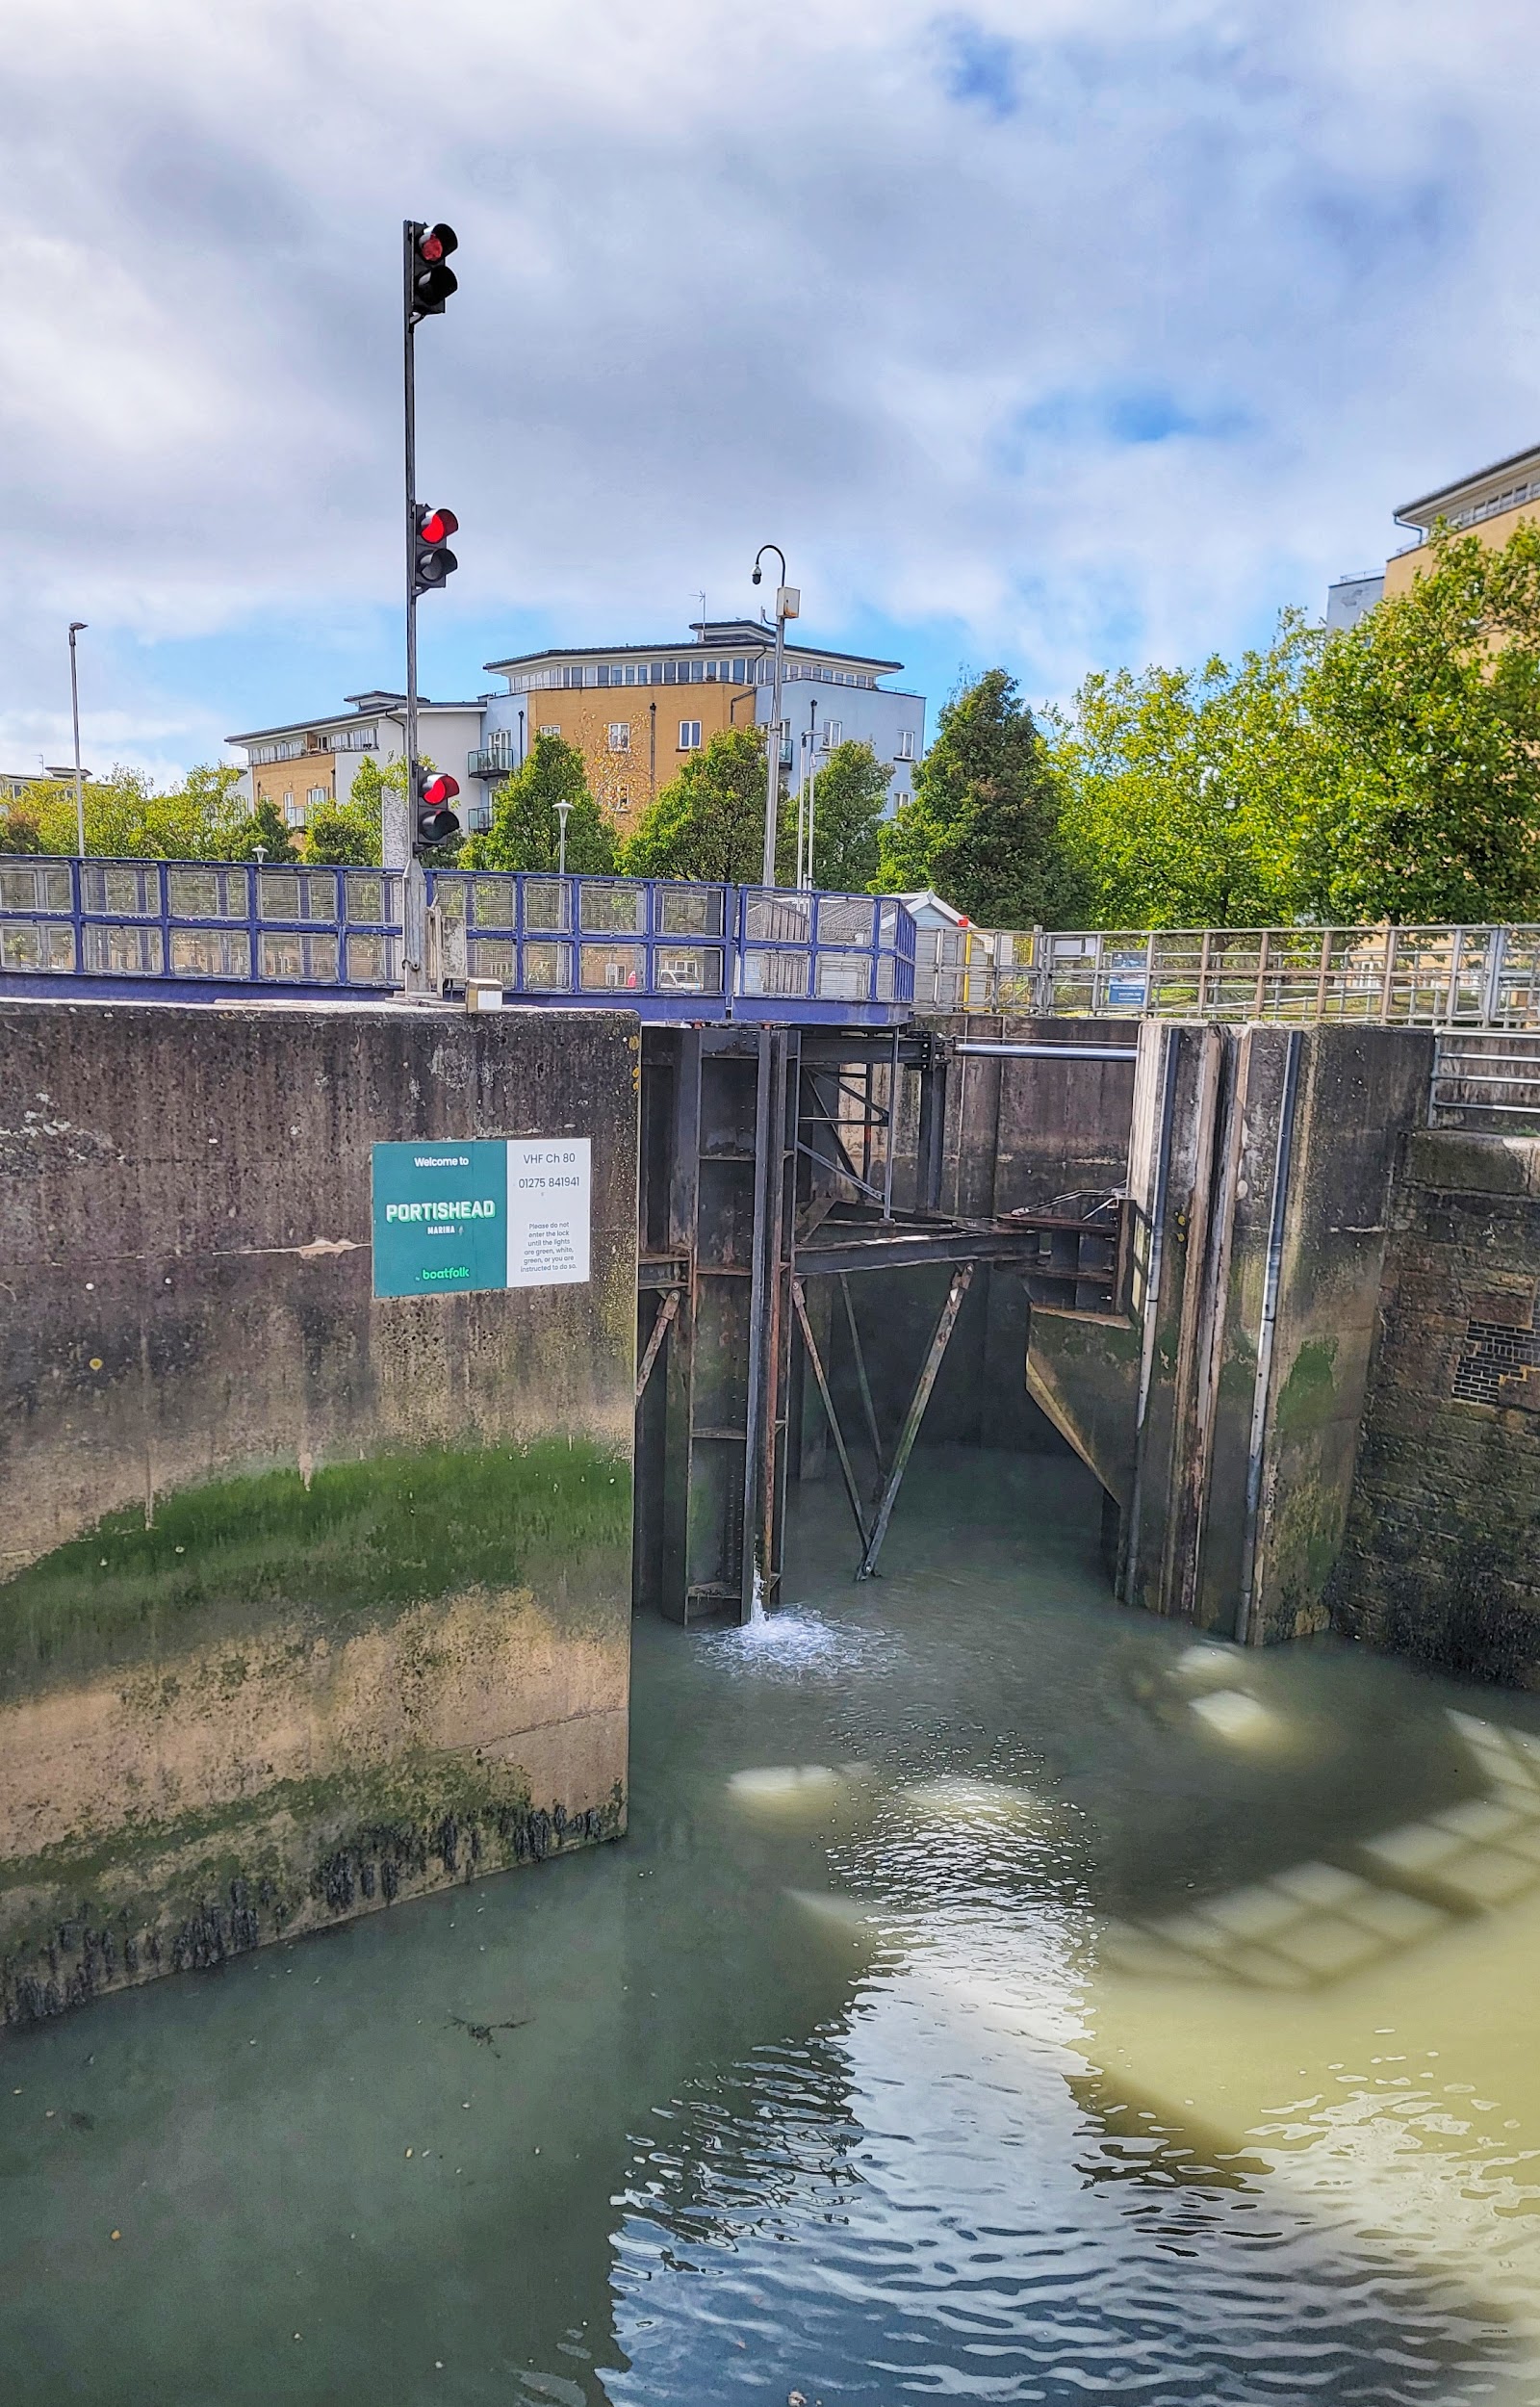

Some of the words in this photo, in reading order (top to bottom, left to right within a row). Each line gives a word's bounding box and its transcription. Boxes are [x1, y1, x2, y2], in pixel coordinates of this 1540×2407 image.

[414, 1156, 458, 1167] Welcome
[459, 1156, 470, 1166] to
[523, 1153, 544, 1164] VHF
[546, 1152, 560, 1163] Ch
[563, 1152, 576, 1163] 80
[518, 1178, 546, 1188] 01275
[548, 1177, 579, 1188] 841941
[386, 1200, 496, 1223] PORTISHEAD
[427, 1225, 455, 1235] MARINA
[553, 1238, 570, 1247] lights
[422, 1267, 470, 1281] boatfolk
